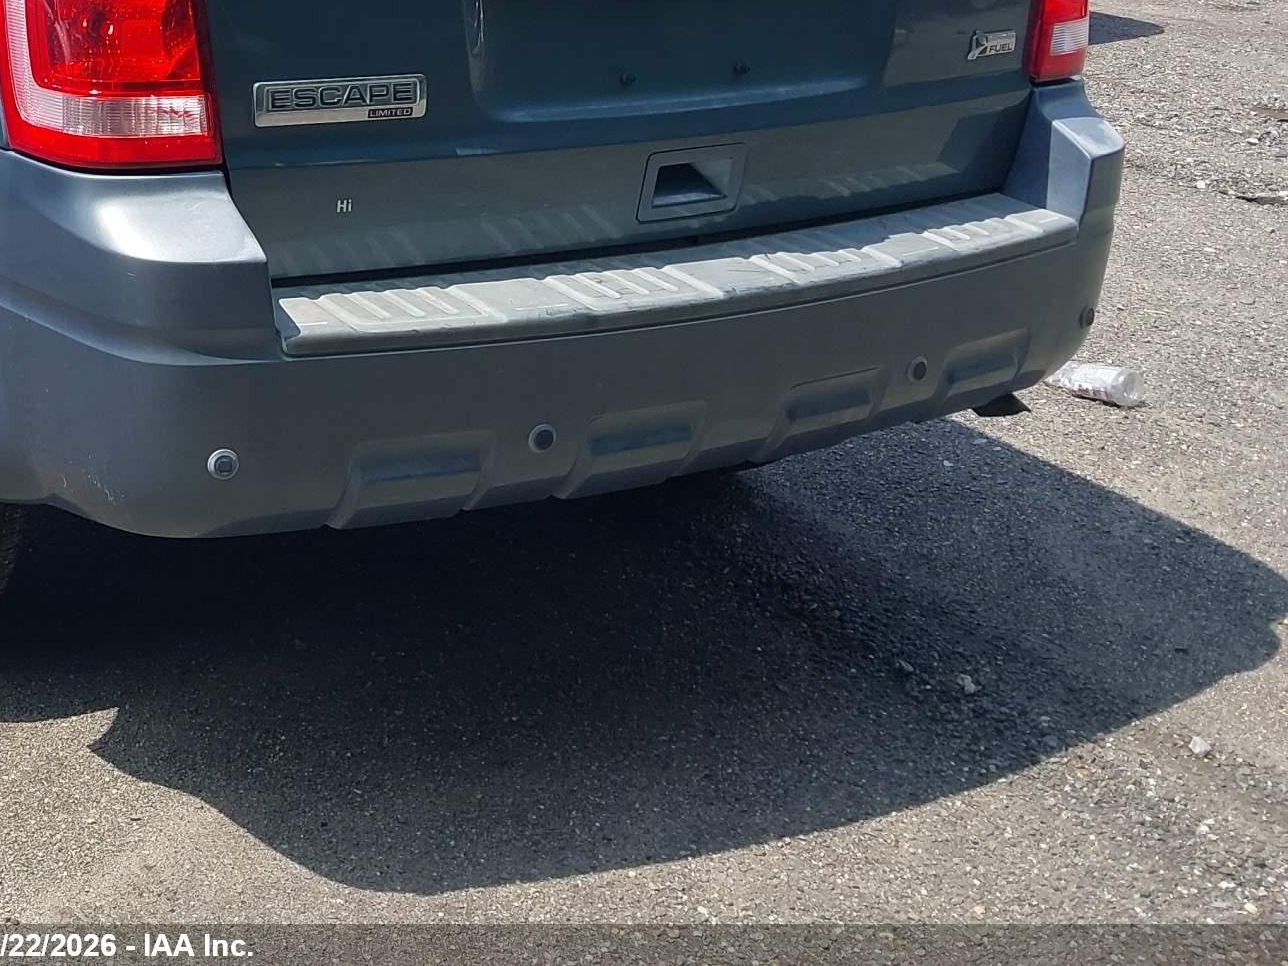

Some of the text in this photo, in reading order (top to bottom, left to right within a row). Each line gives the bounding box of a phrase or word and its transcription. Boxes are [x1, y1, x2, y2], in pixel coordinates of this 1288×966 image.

[988, 43, 1012, 53] FUEL
[270, 83, 414, 110] ESCAPE
[368, 108, 412, 118] LIMITED
[336, 198, 352, 213] Hi
